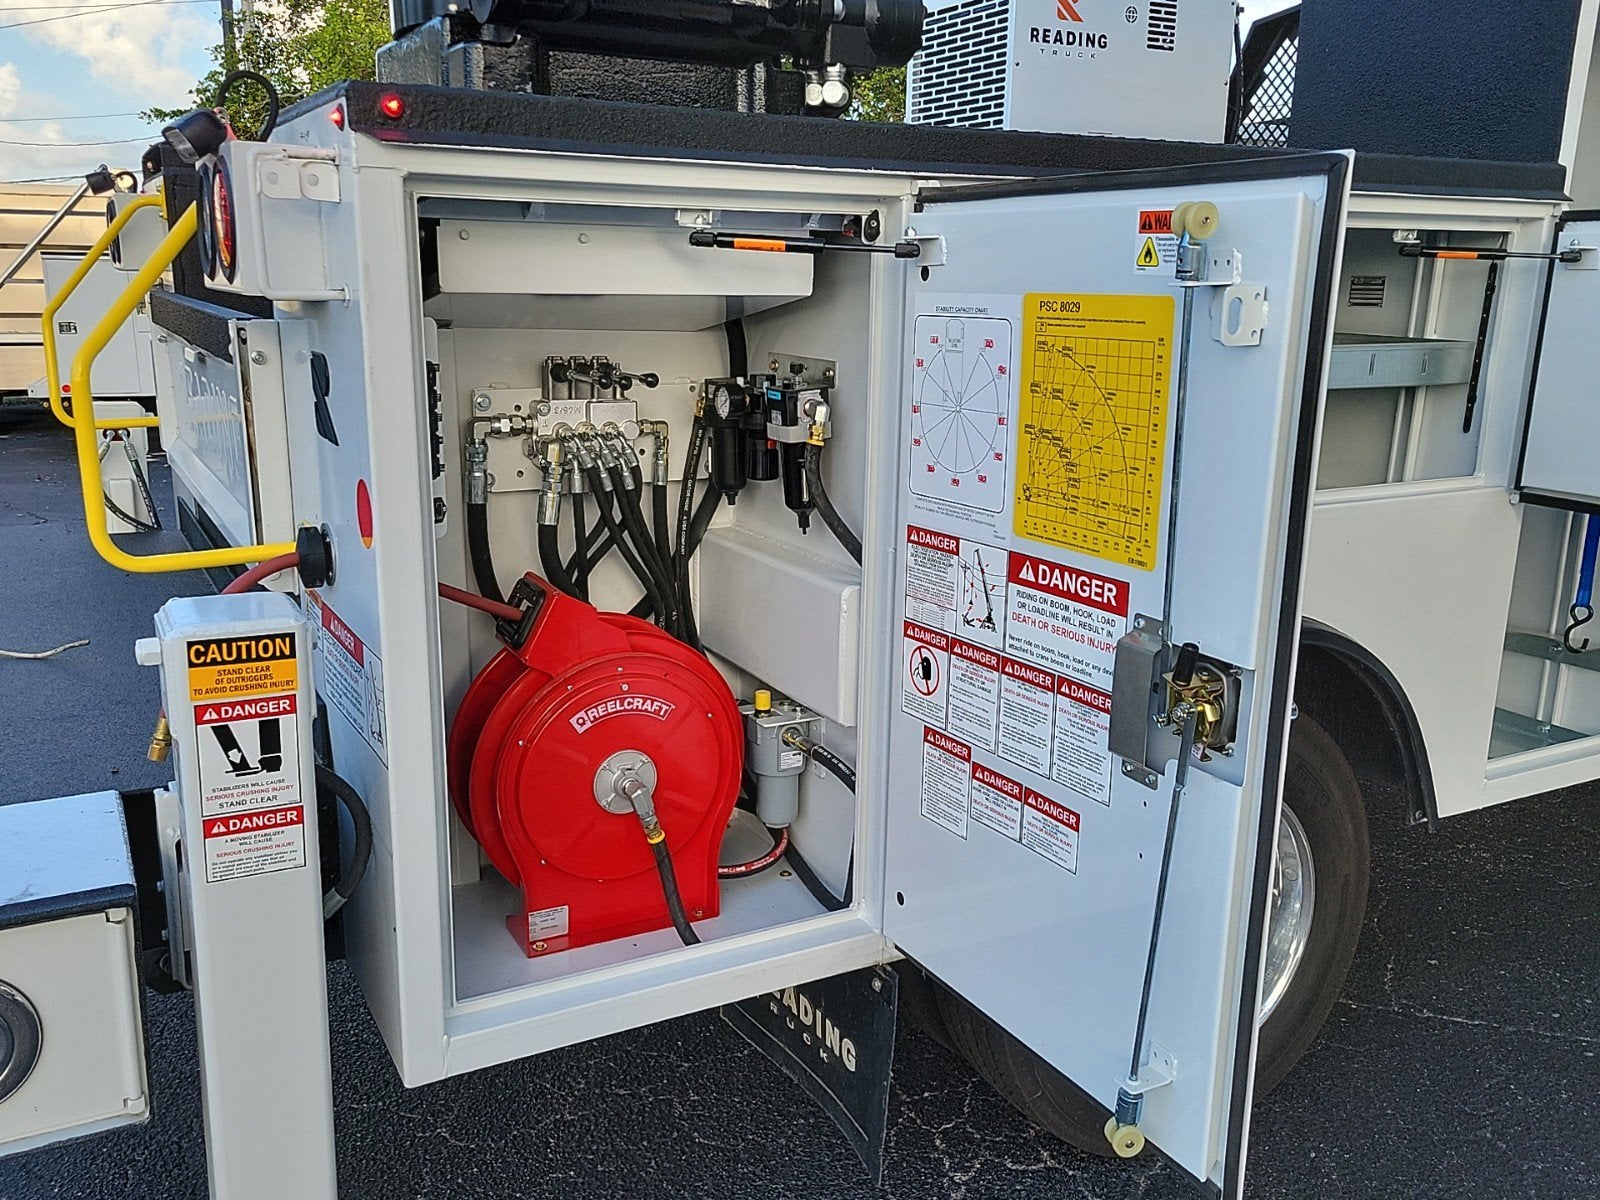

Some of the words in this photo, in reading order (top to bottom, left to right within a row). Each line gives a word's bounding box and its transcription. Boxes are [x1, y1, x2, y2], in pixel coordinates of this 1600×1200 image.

[1030, 28, 1108, 49] READING
[1040, 49, 1096, 59] TRUCK
[1040, 300, 1058, 312] PSC
[1060, 301, 1080, 313] 8029
[919, 531, 957, 552] DANGER
[1038, 564, 1116, 606] DANGER
[1016, 589, 1038, 602] RIDING
[1039, 596, 1048, 606] ON
[1050, 600, 1072, 614] BOOM,
[1073, 608, 1094, 621] HOOK,
[1097, 615, 1116, 628] LOAD
[1017, 601, 1027, 610] OR
[1028, 605, 1059, 621] LOADLINE
[1061, 615, 1077, 627] WILL
[1078, 621, 1105, 635] RESULT
[1106, 629, 1114, 638] IN
[914, 630, 947, 649] DANGER
[1012, 612, 1036, 627] DEATH
[1038, 620, 1049, 631] OR
[1051, 624, 1086, 643] SERIOUS
[1088, 636, 1117, 654] INJURY
[190, 637, 290, 664] CAUTION
[962, 644, 997, 667] DANGER
[1008, 634, 1023, 642] Never
[1024, 638, 1033, 647] ride
[1072, 655, 1084, 665] load
[1092, 664, 1101, 674] any
[1008, 642, 1028, 654] attached
[1036, 652, 1049, 662] crane
[1050, 657, 1064, 668] boom
[217, 668, 243, 677] STAND
[246, 665, 270, 674] CLEAR
[226, 673, 273, 684] OUTRIGGERS
[1014, 664, 1052, 688] DANGER
[205, 686, 227, 695] AVOID
[229, 682, 268, 693] CRUSHING
[270, 679, 295, 688] INJURY
[1070, 684, 1111, 711] DANGER
[222, 699, 291, 718] DANGER
[587, 698, 669, 721] REELCRAFT
[935, 734, 968, 759] DANGER
[206, 793, 235, 801] SERIOUS
[236, 788, 270, 797] CRUSHING
[272, 784, 294, 792] INJURY
[212, 783, 249, 793] STABILIZERS
[984, 770, 1020, 797] DANGER
[219, 800, 248, 809] STAND
[249, 794, 278, 804] CLEAR
[1037, 797, 1076, 827] DANGER
[229, 810, 298, 831] DANGER
[254, 829, 284, 838] STABILIZER
[216, 849, 241, 858] SERIOUS
[243, 844, 272, 853] CRUSHING
